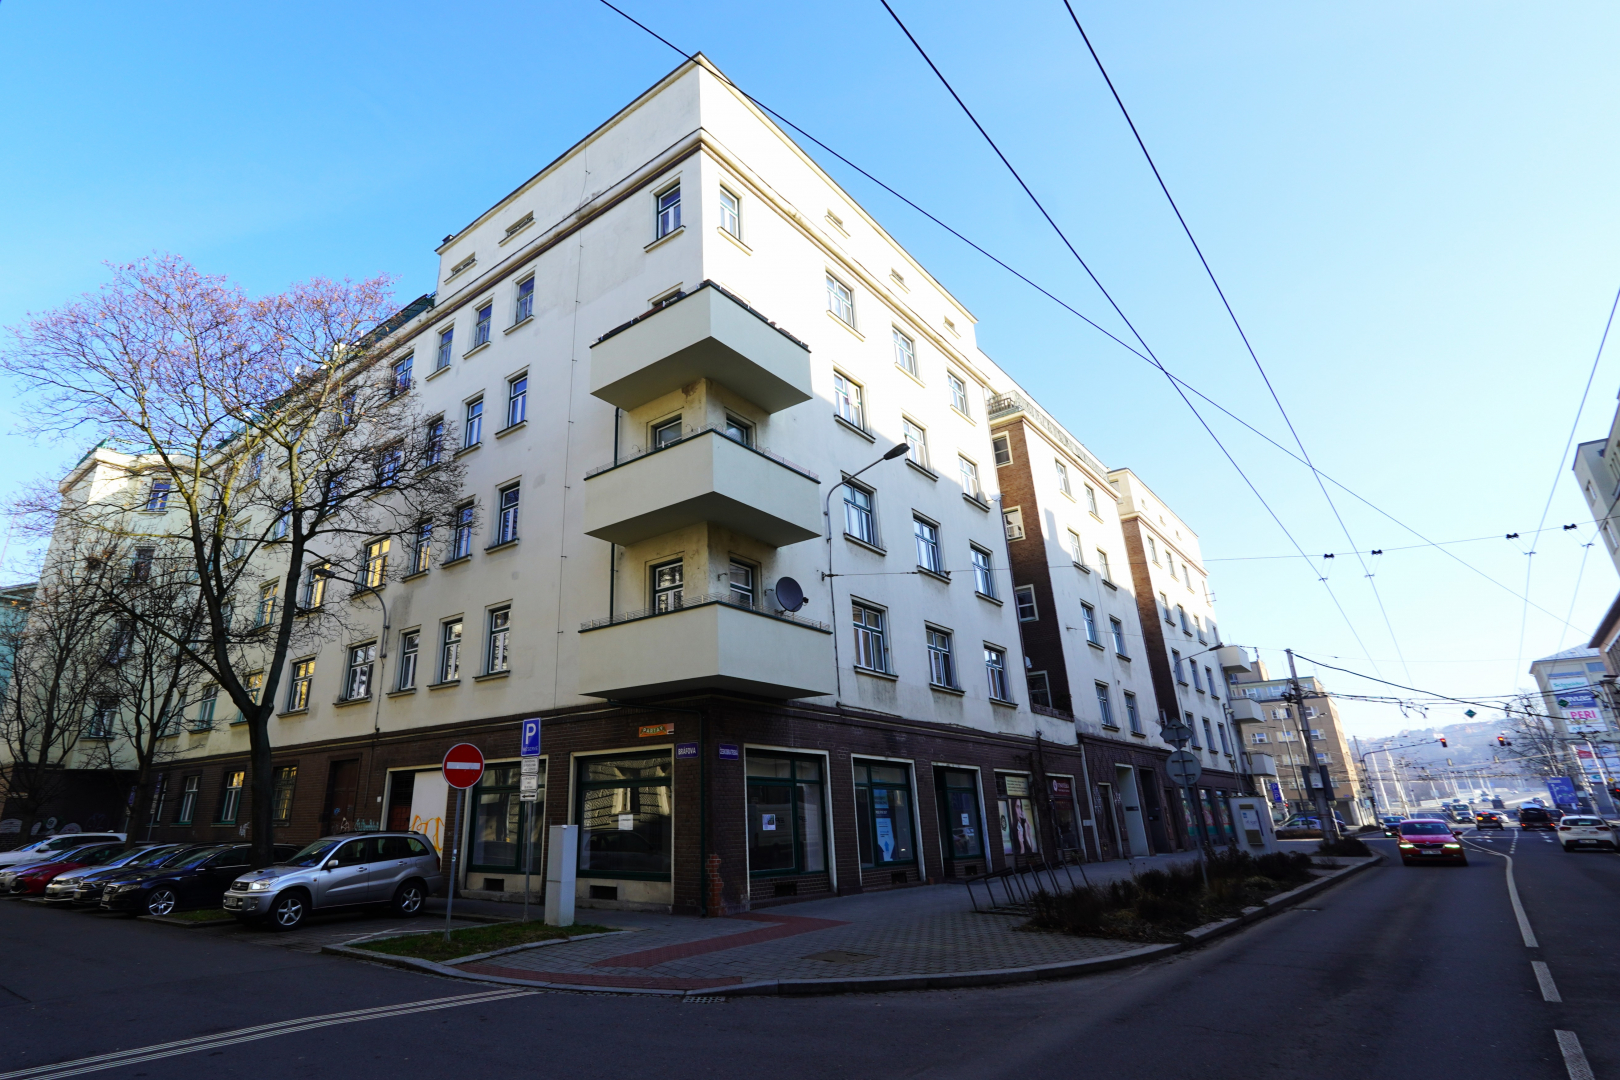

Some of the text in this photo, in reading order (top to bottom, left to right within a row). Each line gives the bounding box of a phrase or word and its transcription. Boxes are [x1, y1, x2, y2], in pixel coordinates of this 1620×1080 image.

[1570, 710, 1597, 720] PERI
[525, 723, 537, 745] P
[678, 747, 697, 755] BRÁFOVA
